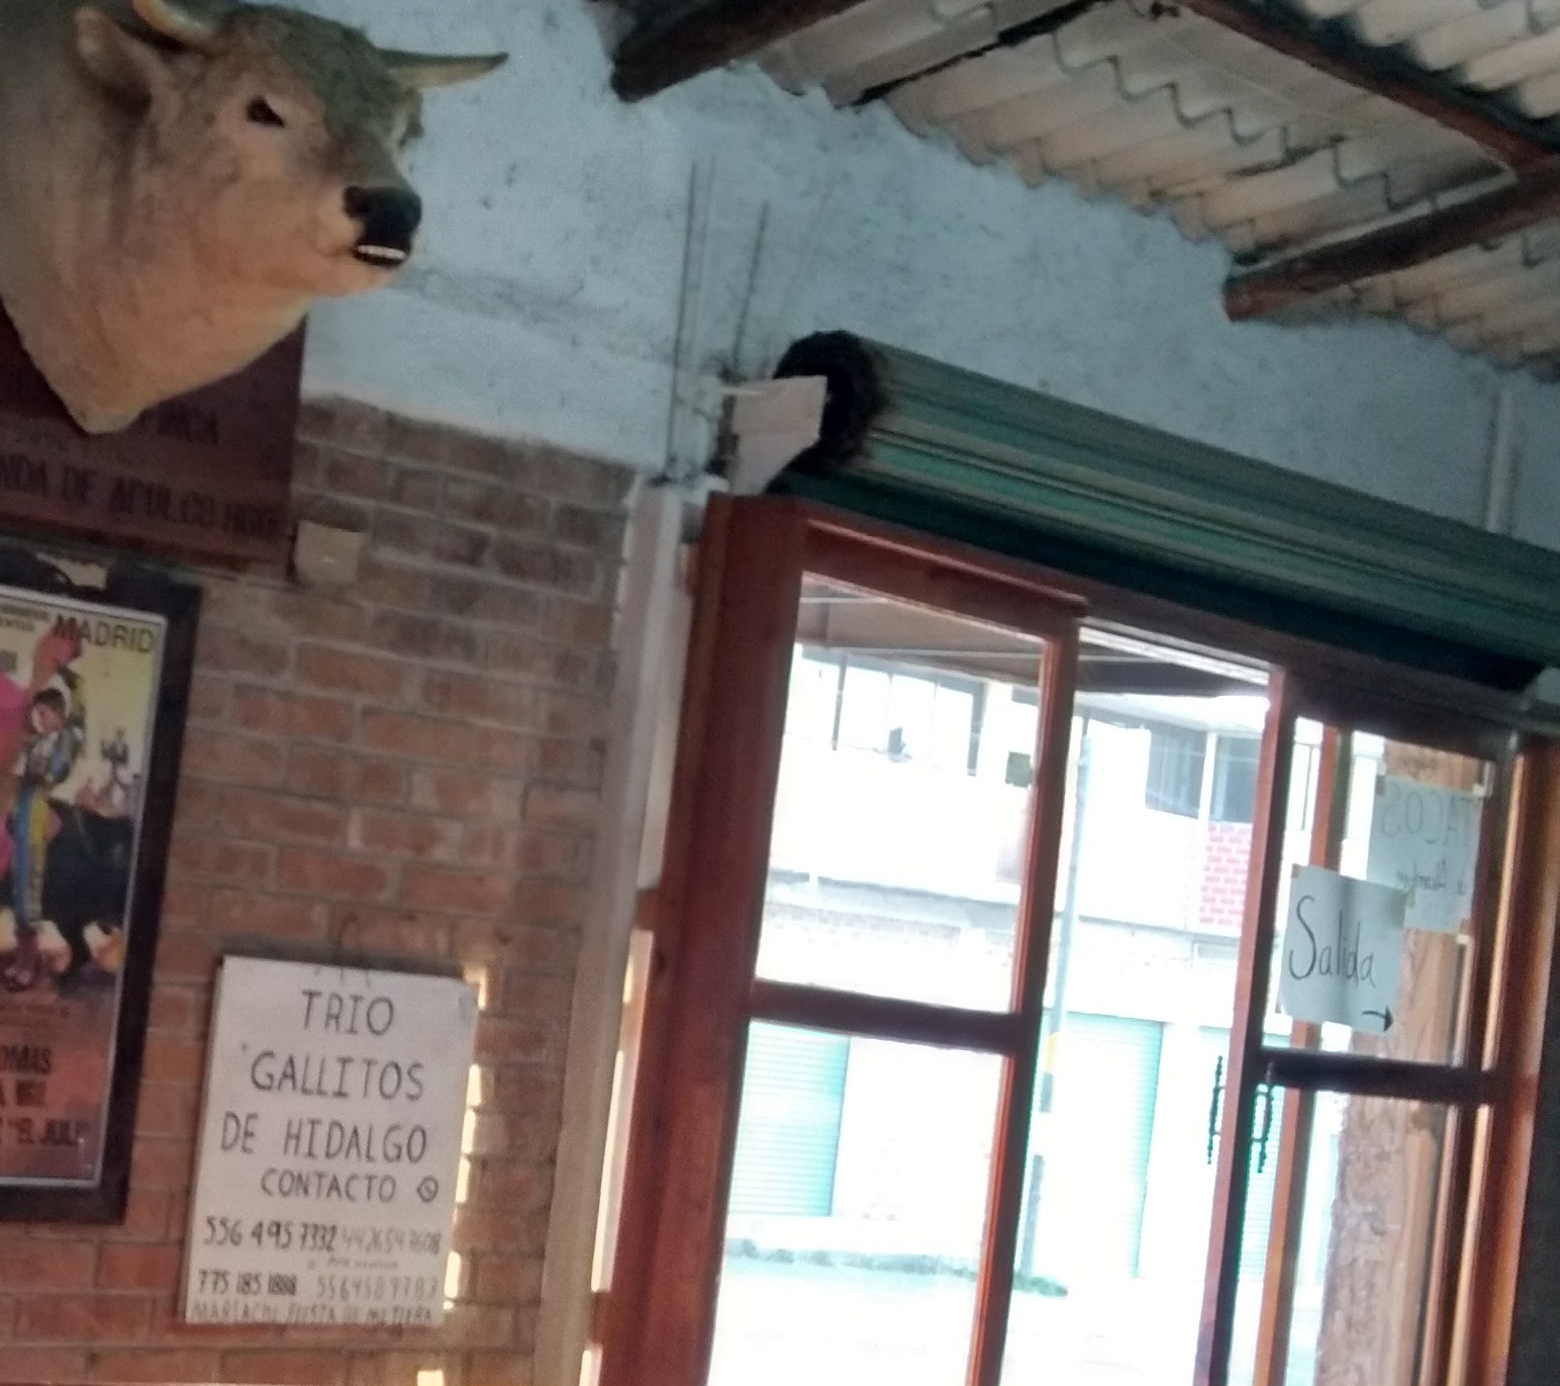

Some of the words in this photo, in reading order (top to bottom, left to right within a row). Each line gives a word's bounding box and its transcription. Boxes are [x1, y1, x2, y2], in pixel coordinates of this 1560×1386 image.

[52, 614, 156, 655] MADRID
[1289, 895, 1376, 987] Salida
[302, 988, 395, 1036] TRIO
[250, 1050, 424, 1101] GALLITOS
[221, 1111, 259, 1154] DE
[284, 1117, 428, 1164] HIDALGO
[260, 1167, 397, 1203] CONTACTO
